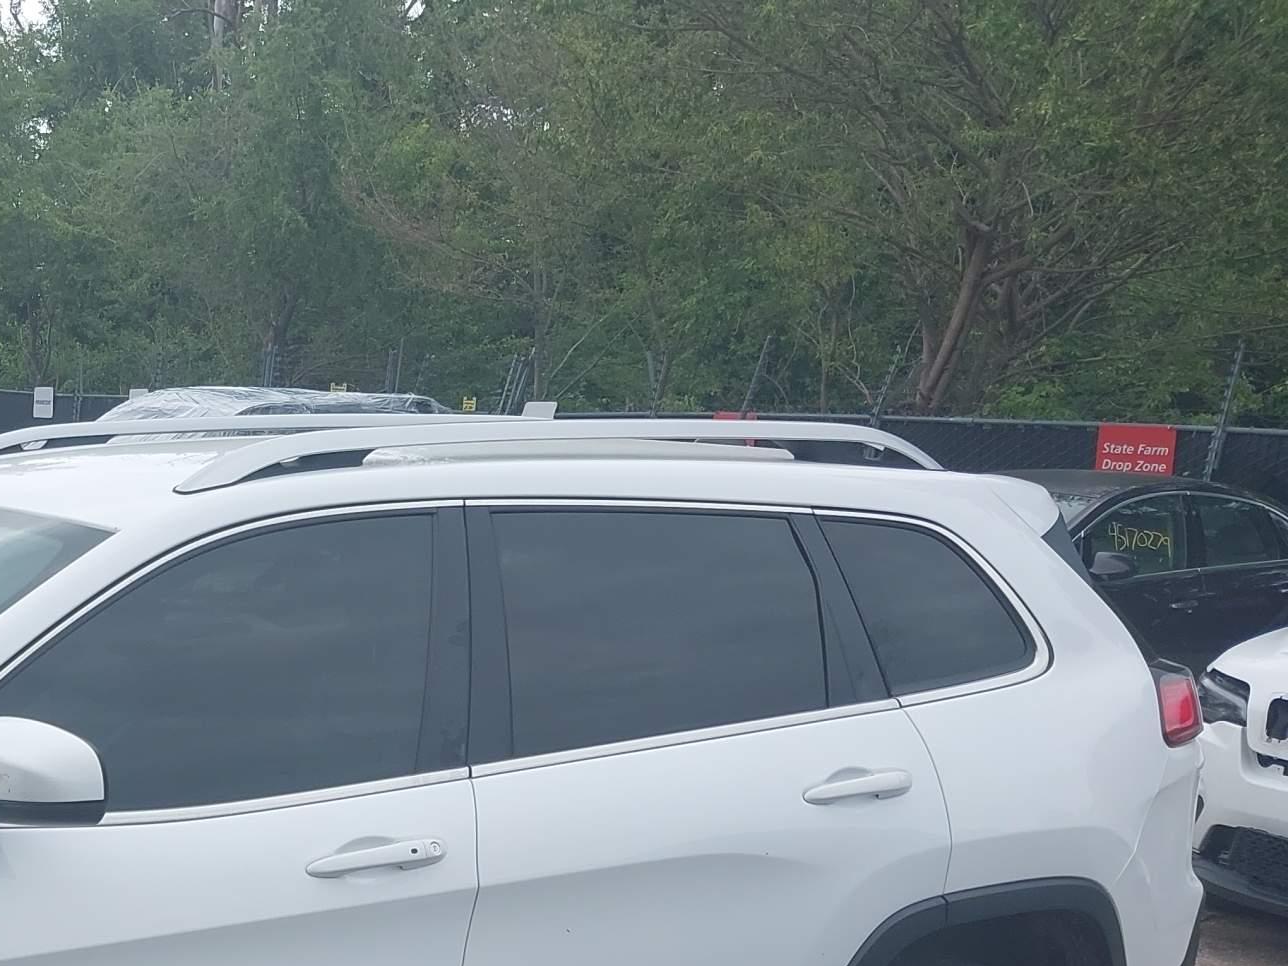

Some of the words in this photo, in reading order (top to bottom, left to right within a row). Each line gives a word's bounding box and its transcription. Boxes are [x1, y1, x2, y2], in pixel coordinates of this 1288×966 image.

[1102, 442, 1134, 454] State
[1137, 444, 1169, 456] Farm
[1102, 459, 1132, 472] Drop
[1134, 460, 1166, 472] Zone
